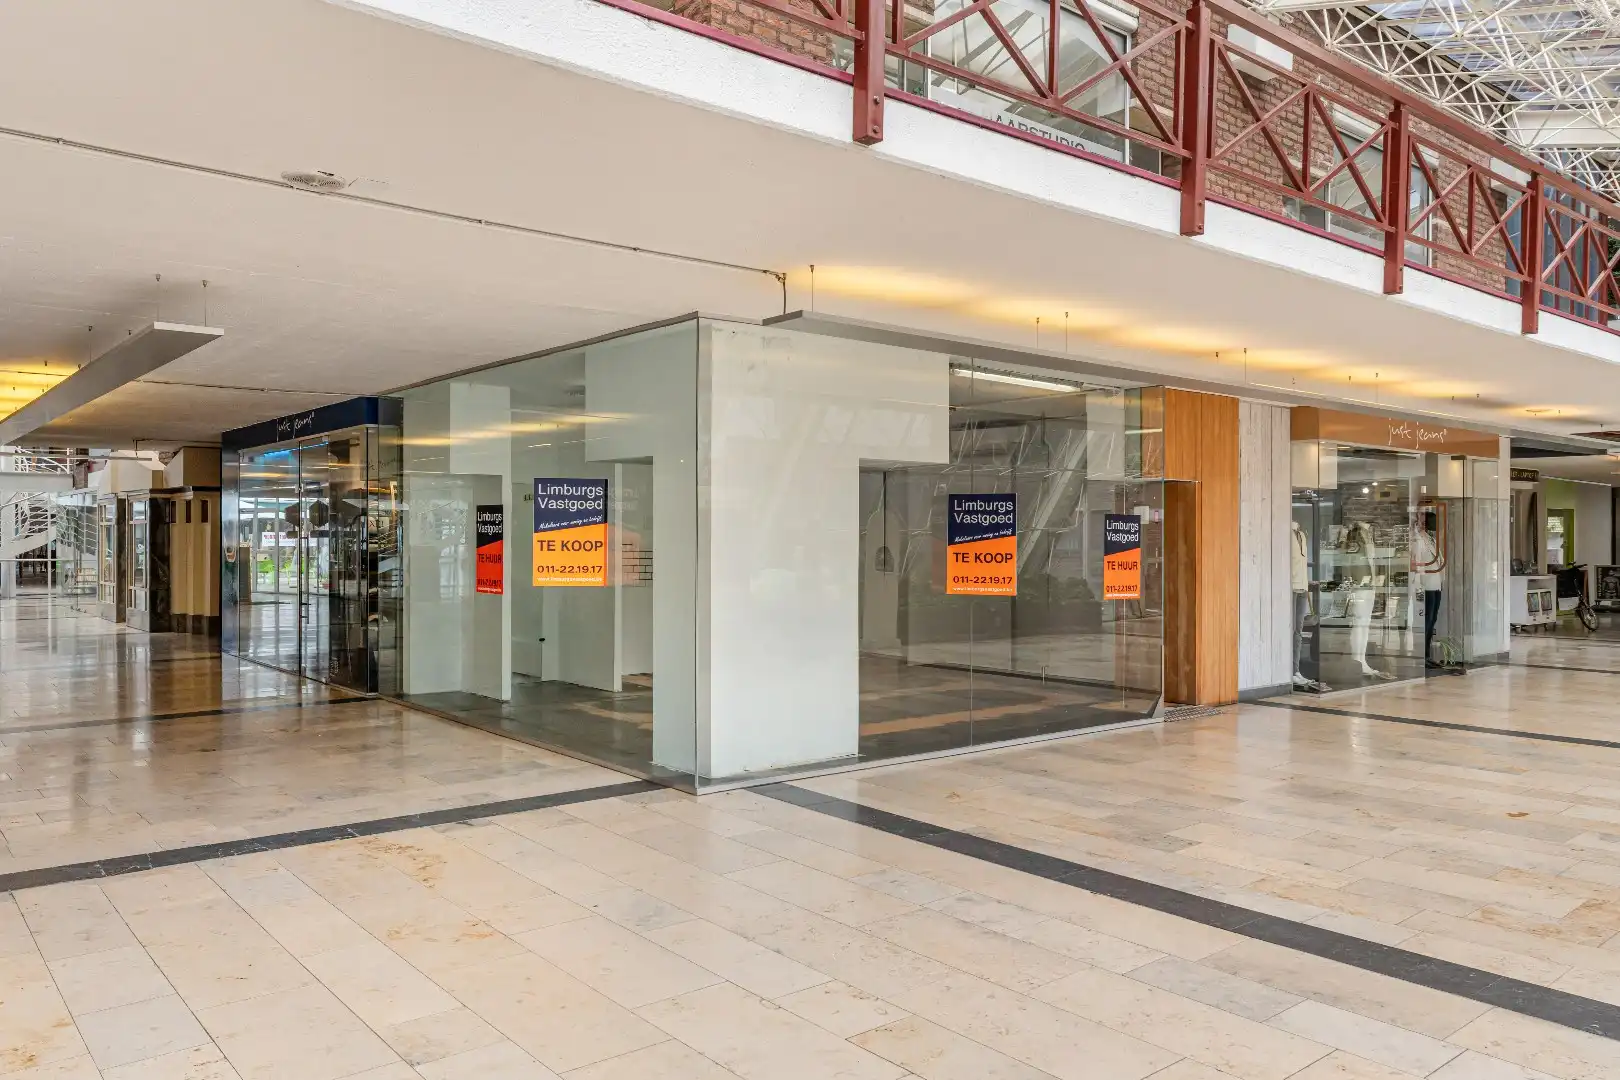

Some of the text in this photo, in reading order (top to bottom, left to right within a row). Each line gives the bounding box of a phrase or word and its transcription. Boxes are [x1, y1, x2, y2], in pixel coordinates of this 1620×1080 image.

[1388, 417, 1445, 450] just jeans
[538, 484, 604, 499] Limburgs
[537, 497, 603, 512] Vastgoed
[954, 500, 1014, 513] Limburgs
[477, 512, 503, 524] Limburgs
[953, 513, 1014, 526] Vastgoed
[477, 523, 503, 536] Vastgoed
[1106, 520, 1139, 533] Limburgs
[1106, 532, 1139, 544] Vastgoed
[537, 540, 604, 552] TE KOOP
[477, 554, 502, 564] TE HUUR
[953, 553, 1014, 564] TE KOOP
[537, 565, 603, 574] 011-22.19.17
[1106, 561, 1138, 571] TE HUUR
[953, 576, 1013, 584] 011-22.19.17
